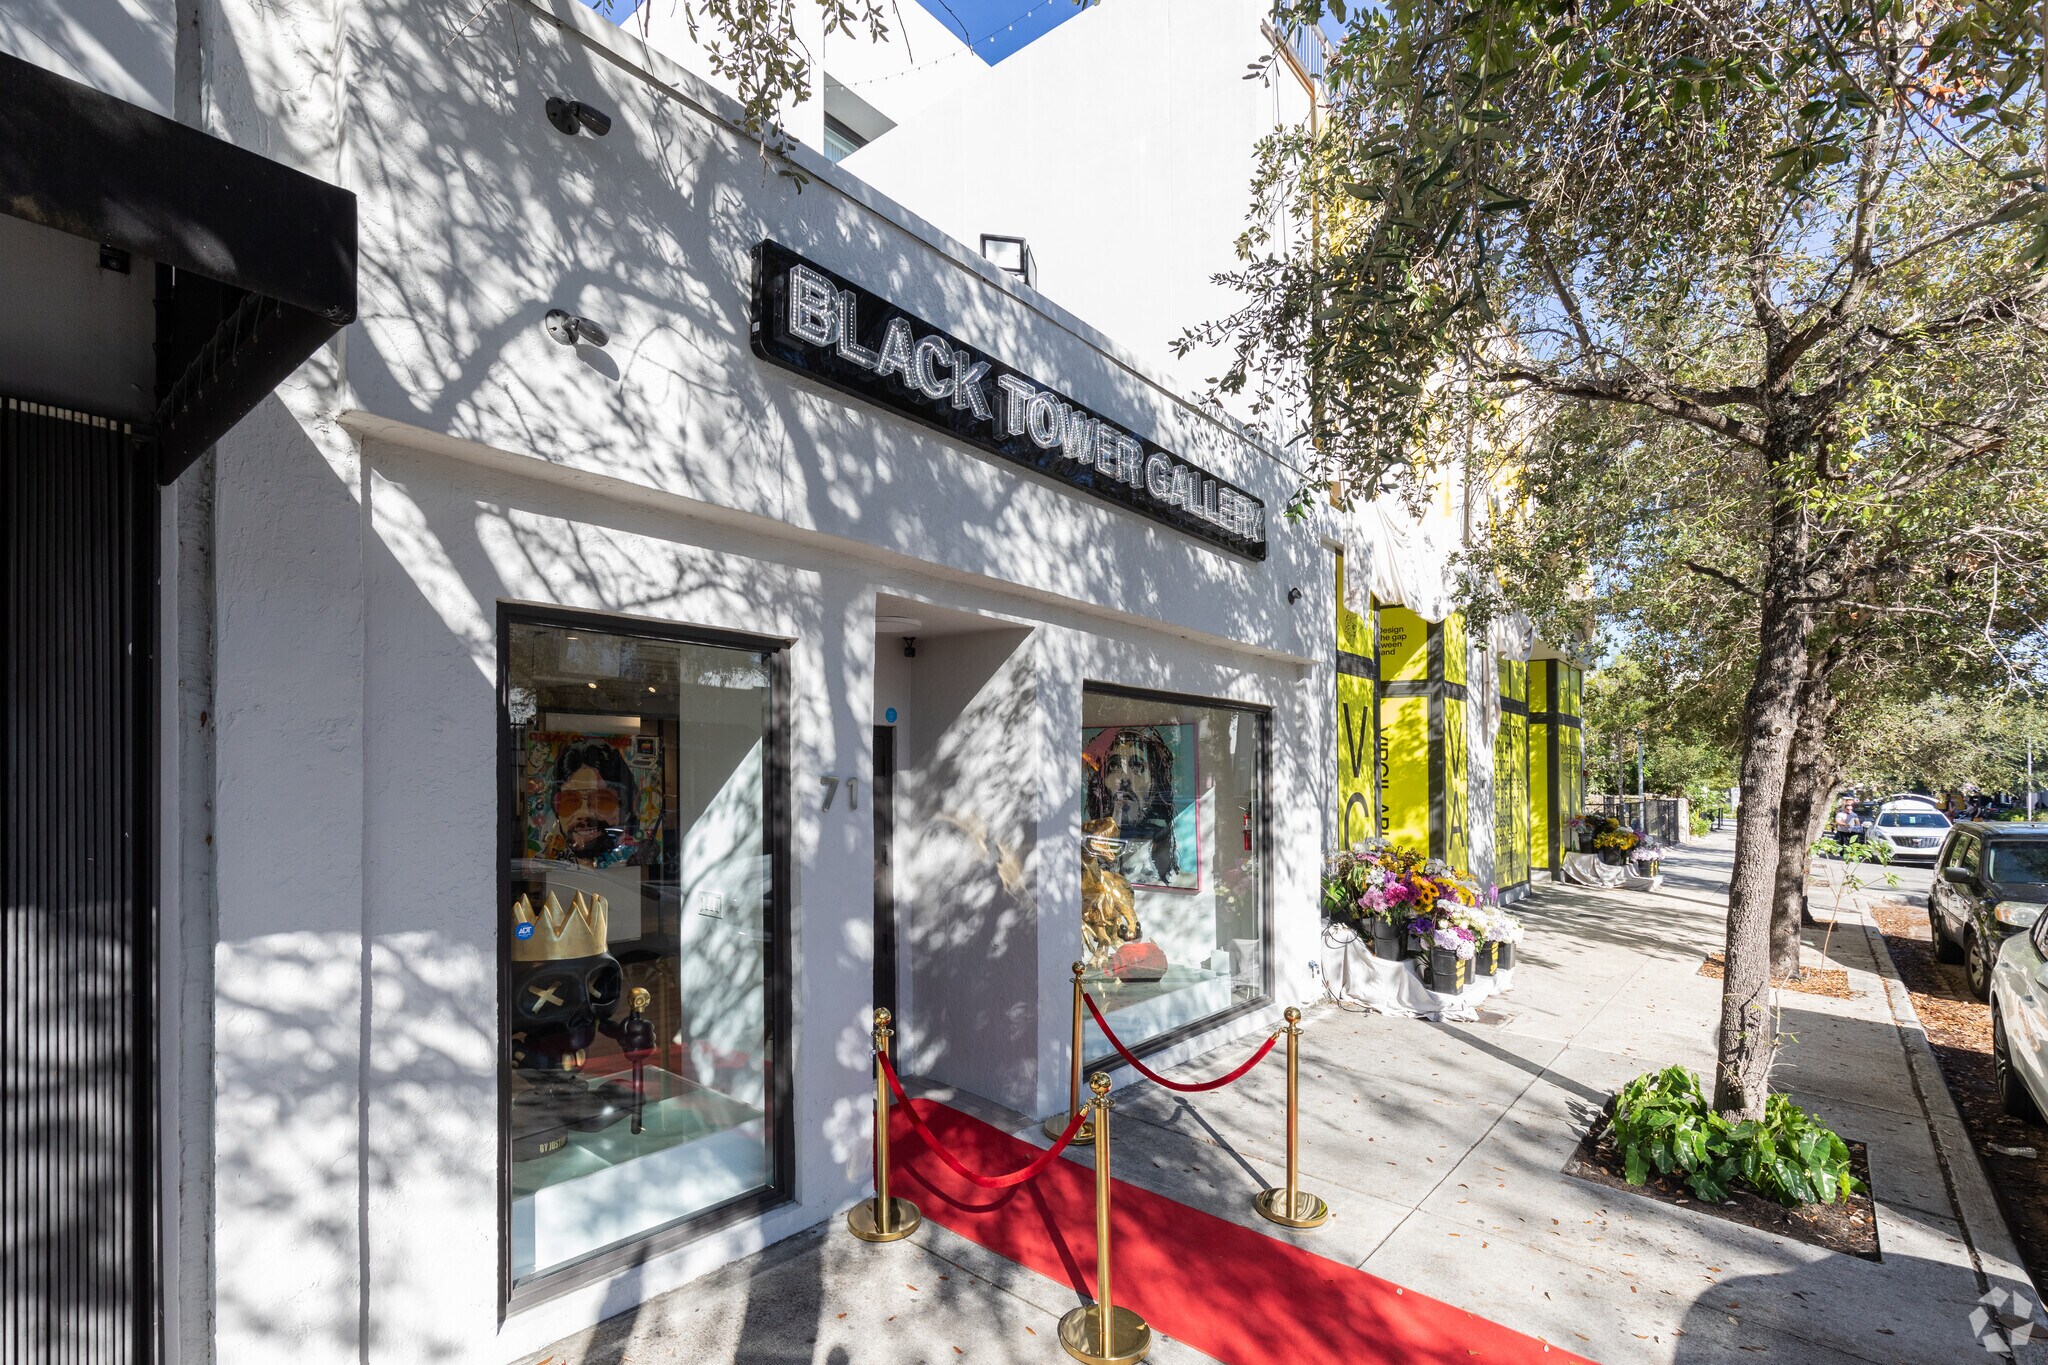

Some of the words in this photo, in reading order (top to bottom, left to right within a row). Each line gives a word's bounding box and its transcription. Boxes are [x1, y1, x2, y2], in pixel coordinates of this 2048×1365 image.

[790, 263, 993, 421] BLACK
[998, 373, 1144, 489] TOWER
[1145, 452, 1265, 542] GALLERY
[820, 775, 858, 812] 71
[518, 926, 532, 935] ADT
